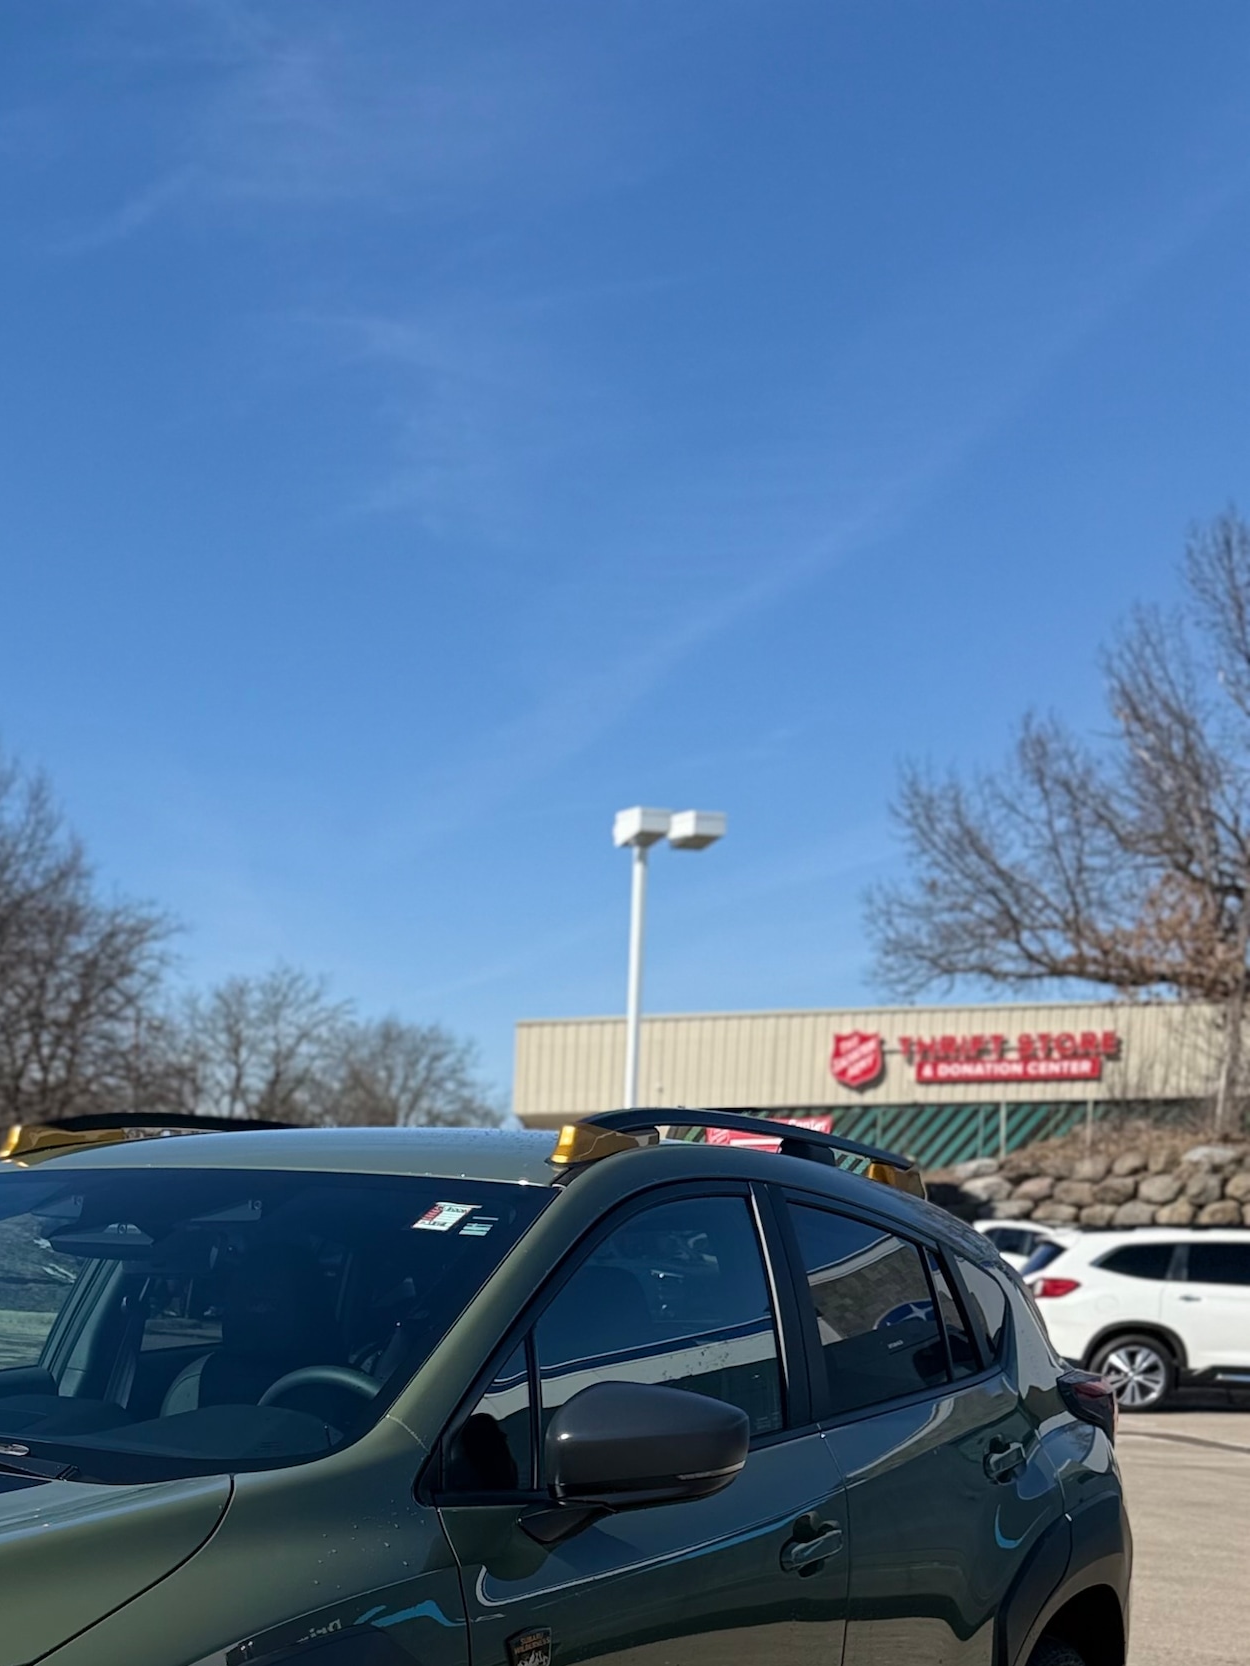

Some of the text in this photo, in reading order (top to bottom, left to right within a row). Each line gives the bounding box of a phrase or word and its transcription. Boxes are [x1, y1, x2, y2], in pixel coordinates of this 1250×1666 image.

[899, 1033, 1004, 1057] THRIFT
[1017, 1030, 1117, 1057] STORE
[937, 1061, 1024, 1077] DONATION
[1027, 1059, 1092, 1075] CENTER
